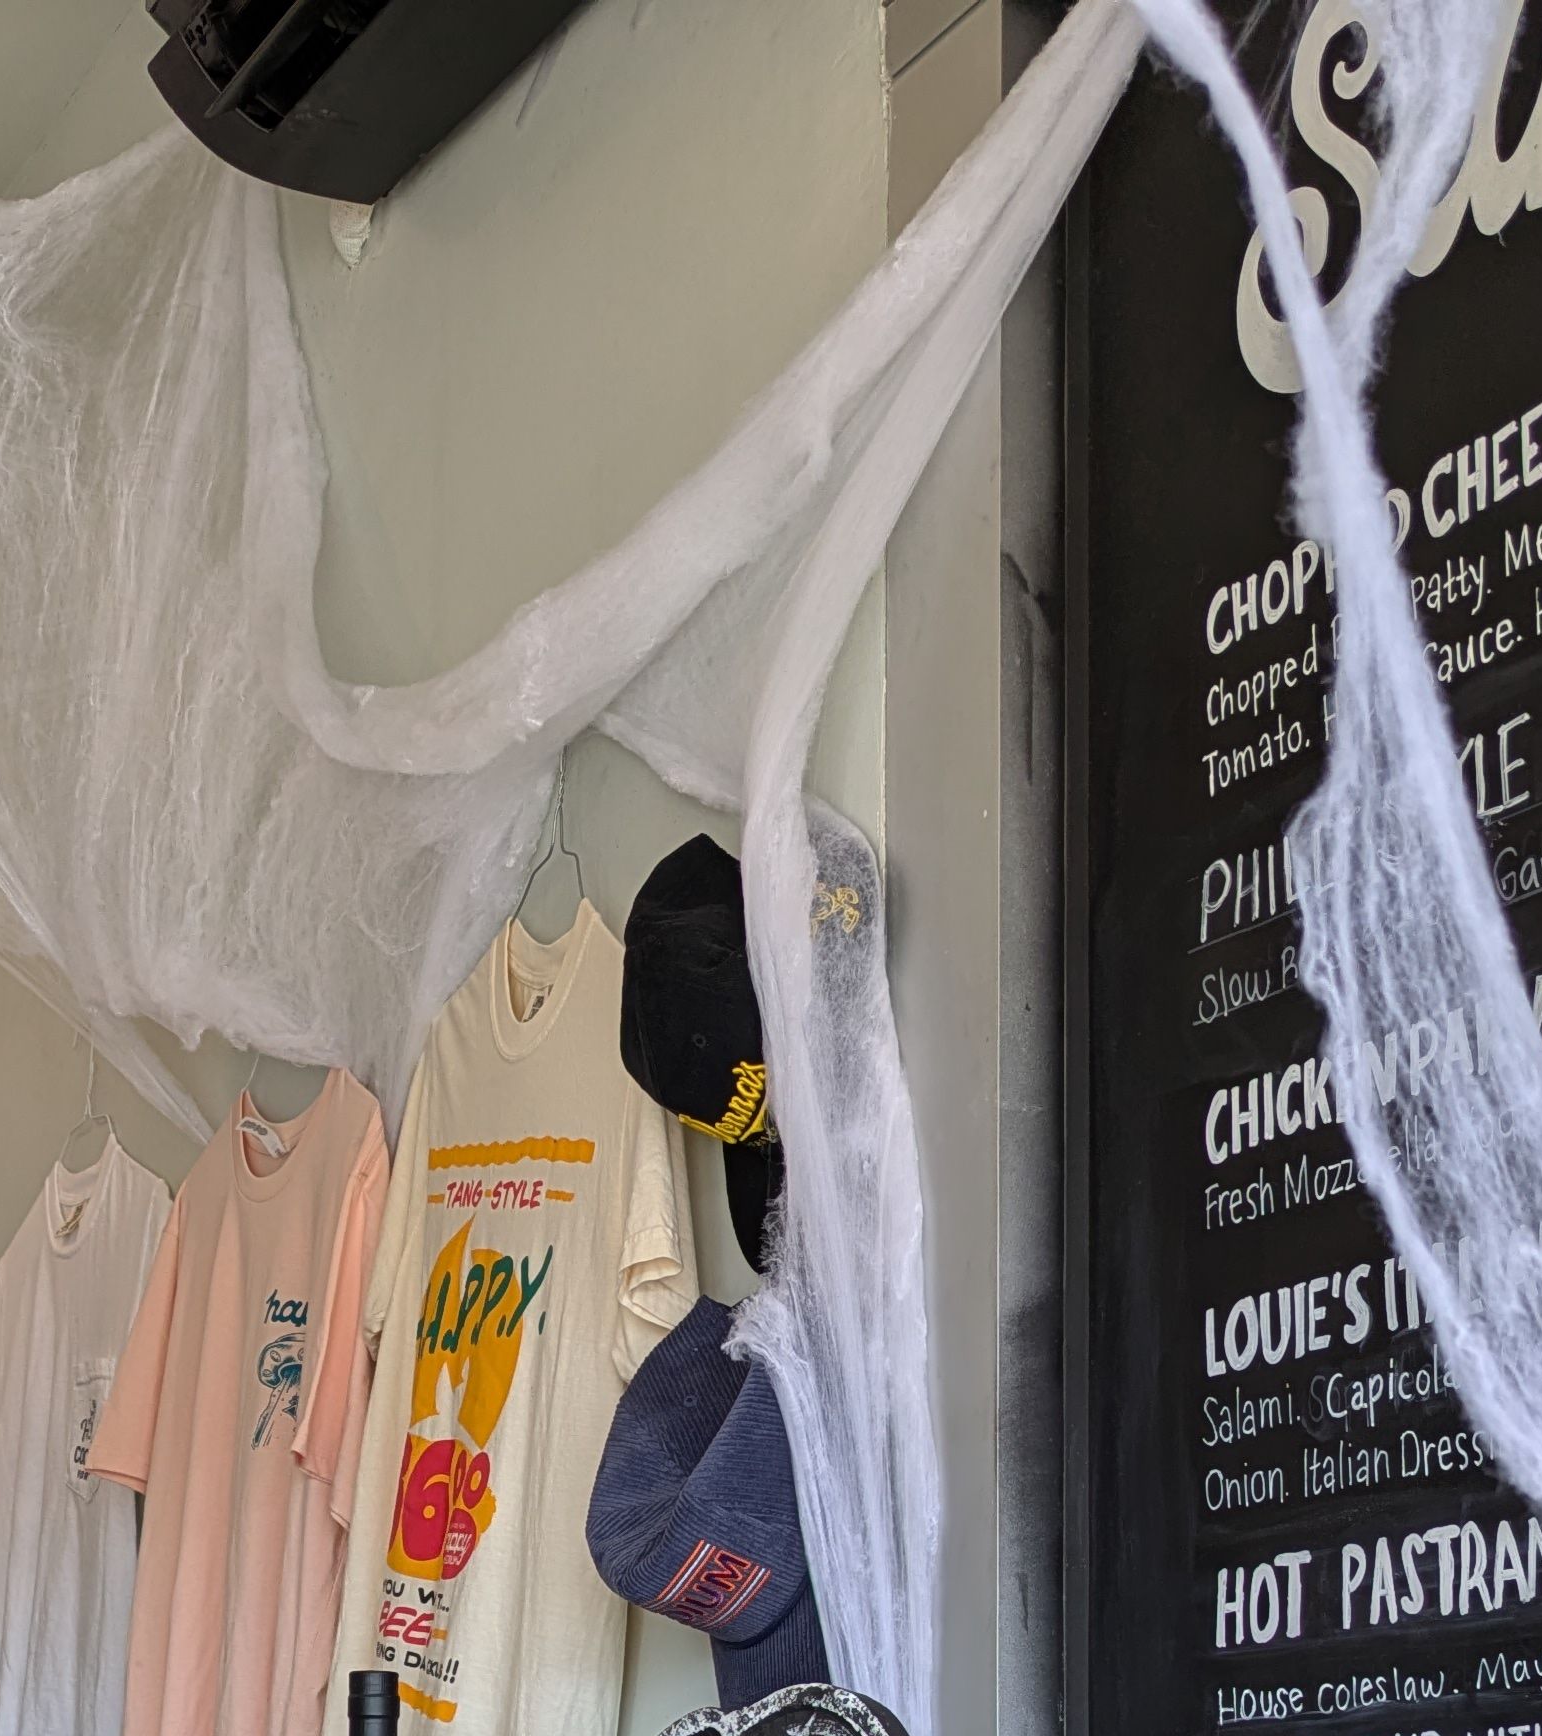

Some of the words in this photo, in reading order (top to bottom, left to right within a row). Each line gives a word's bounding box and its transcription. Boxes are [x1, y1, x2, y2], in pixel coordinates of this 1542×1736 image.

[1206, 621, 1317, 727] Chopped
[1202, 724, 1311, 797] Tomato.
[1198, 945, 1271, 1024] Slow
[1204, 1165, 1275, 1230] Fresh
[1206, 1263, 1371, 1377] LOUIE'S
[1202, 1384, 1301, 1446] Salami.
[1205, 1452, 1291, 1512] Onion.
[1301, 1430, 1390, 1499] Italian
[1216, 1550, 1311, 1648] HOT
[1217, 1686, 1305, 1726] House
